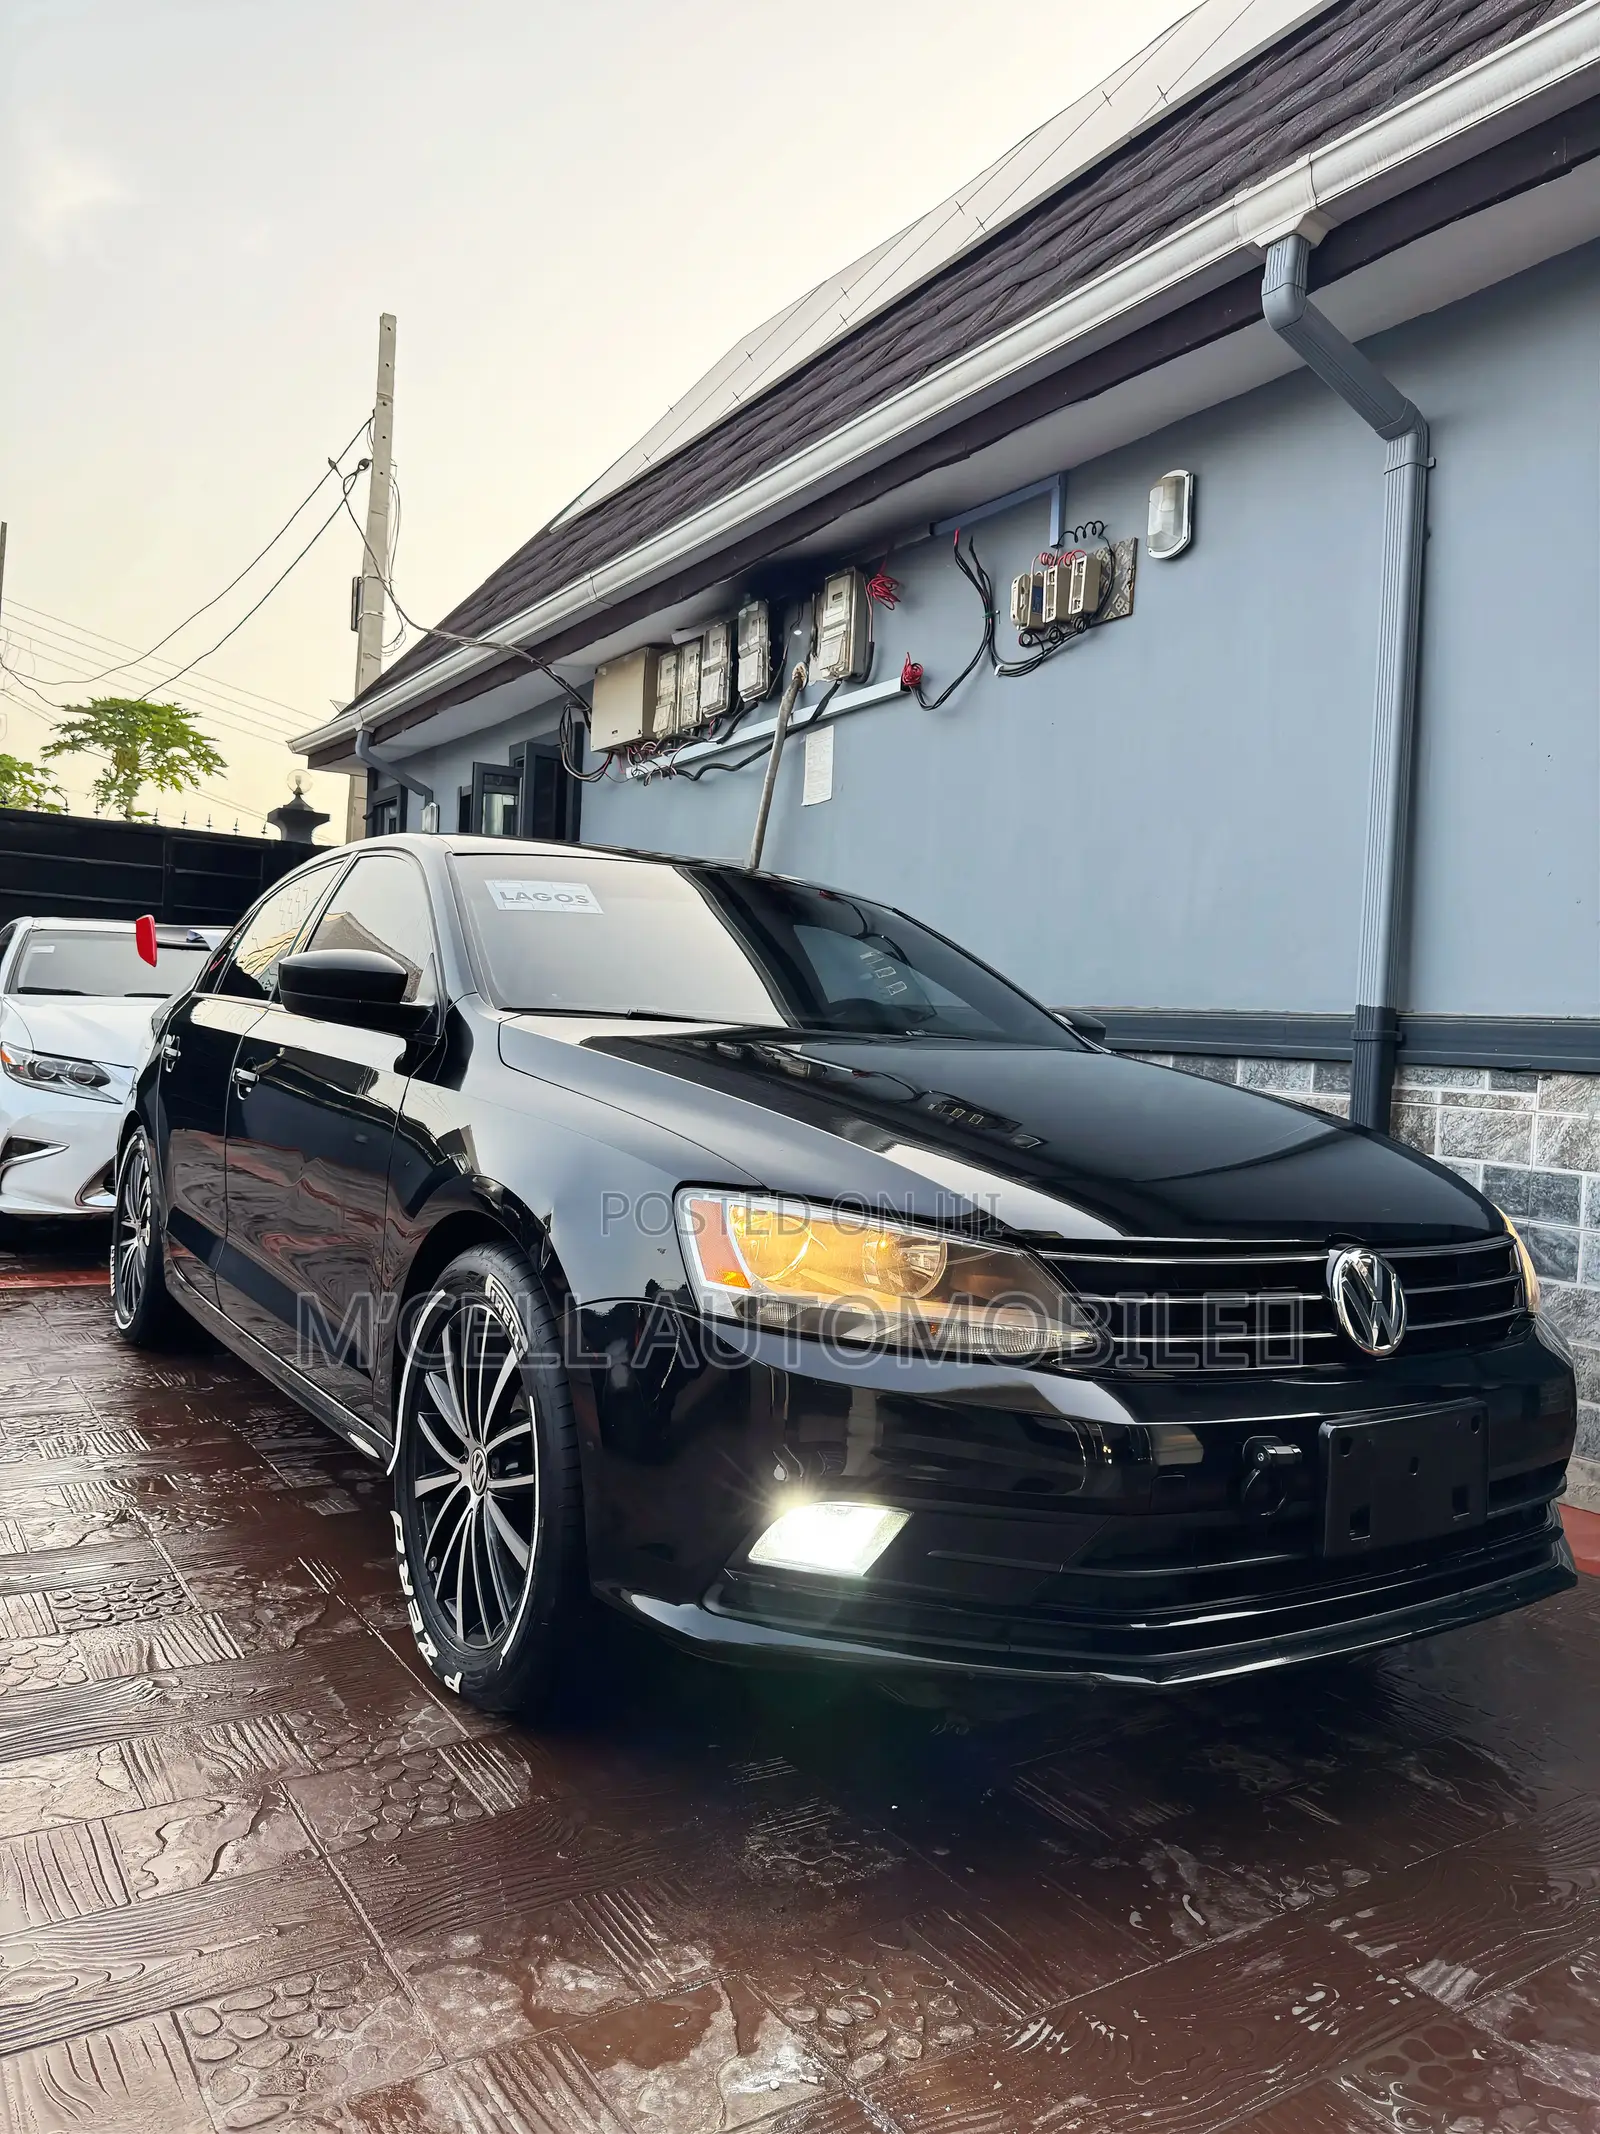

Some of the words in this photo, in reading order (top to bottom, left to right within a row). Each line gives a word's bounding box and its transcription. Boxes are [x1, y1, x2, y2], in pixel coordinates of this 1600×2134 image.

[499, 891, 591, 905] LAGOS
[390, 1510, 438, 1667] ZERO
[444, 1671, 463, 1694] P
